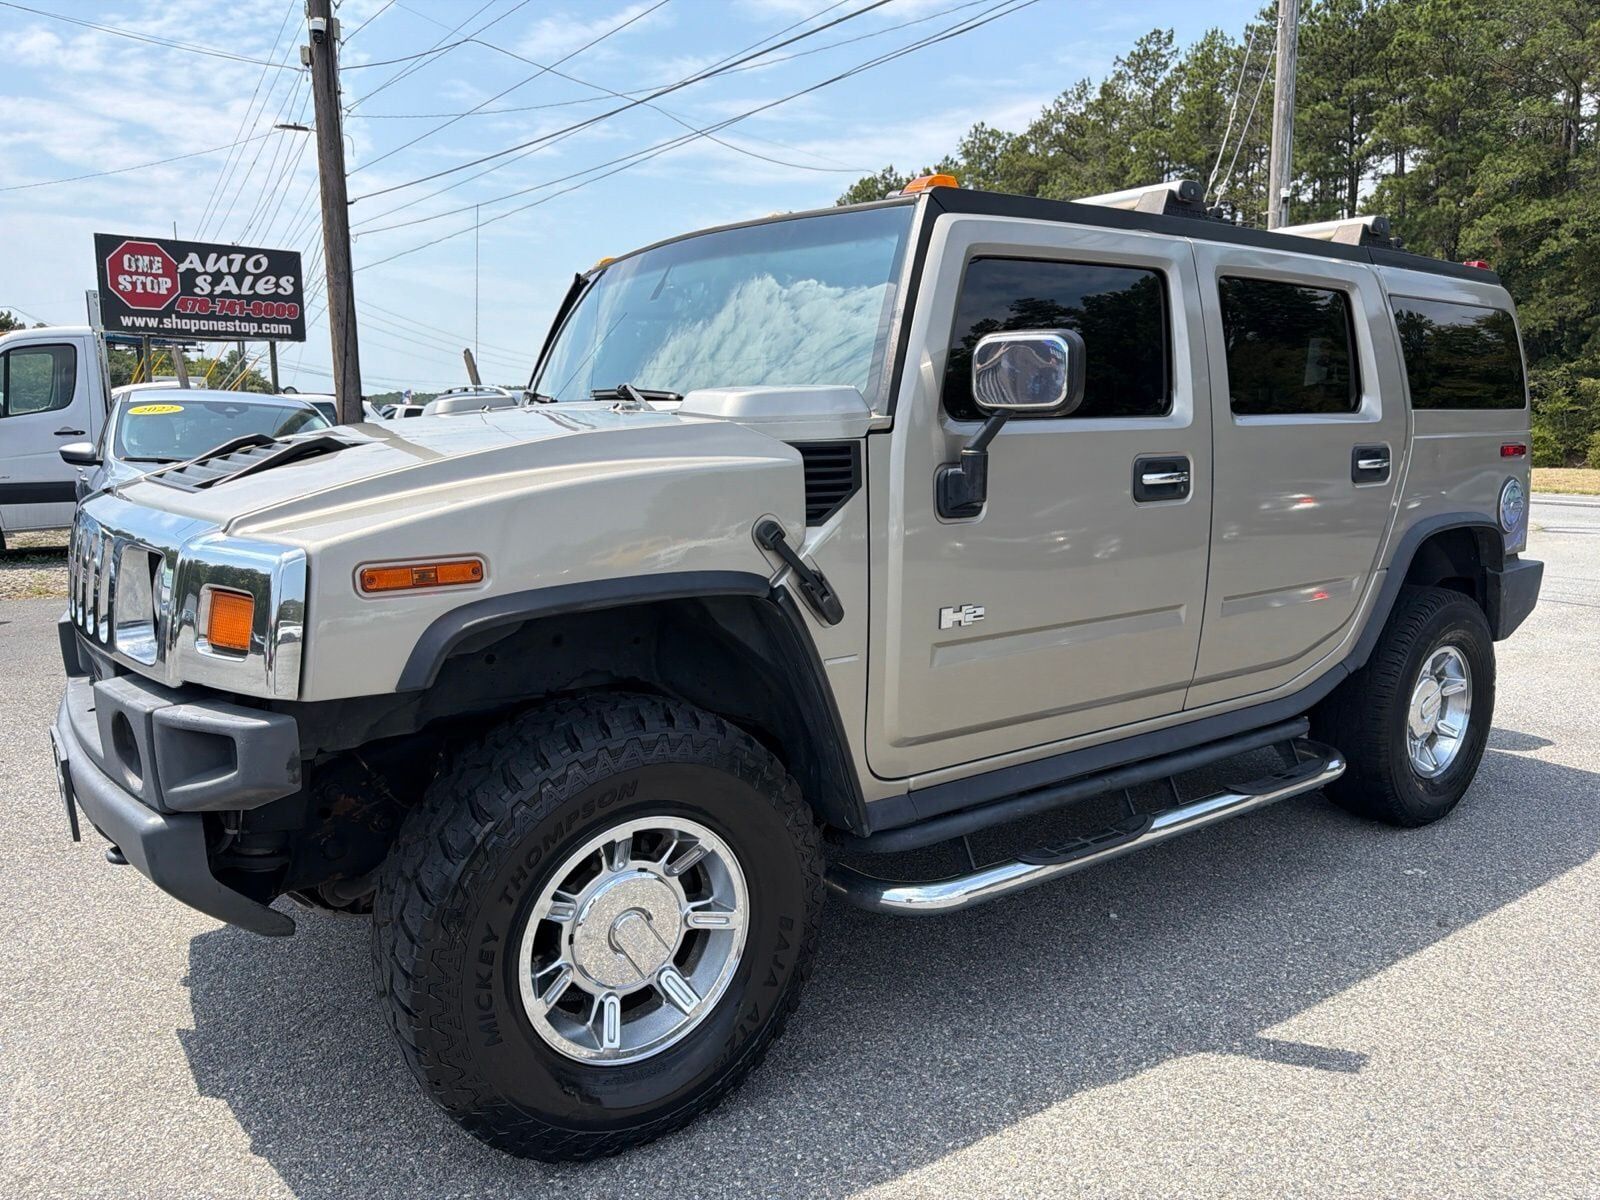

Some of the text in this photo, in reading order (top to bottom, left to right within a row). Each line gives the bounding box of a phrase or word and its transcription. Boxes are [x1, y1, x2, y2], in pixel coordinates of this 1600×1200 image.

[123, 253, 163, 274] ONE
[177, 252, 269, 274] AUTO
[118, 274, 172, 295] STOP
[193, 274, 295, 296] SALES
[175, 296, 300, 320] 478-741-8009
[120, 314, 292, 336] www.shoponestop.com
[939, 604, 985, 630] H2
[474, 779, 639, 1048] MICKEY THOMPSON
[762, 915, 795, 988] BAJA
